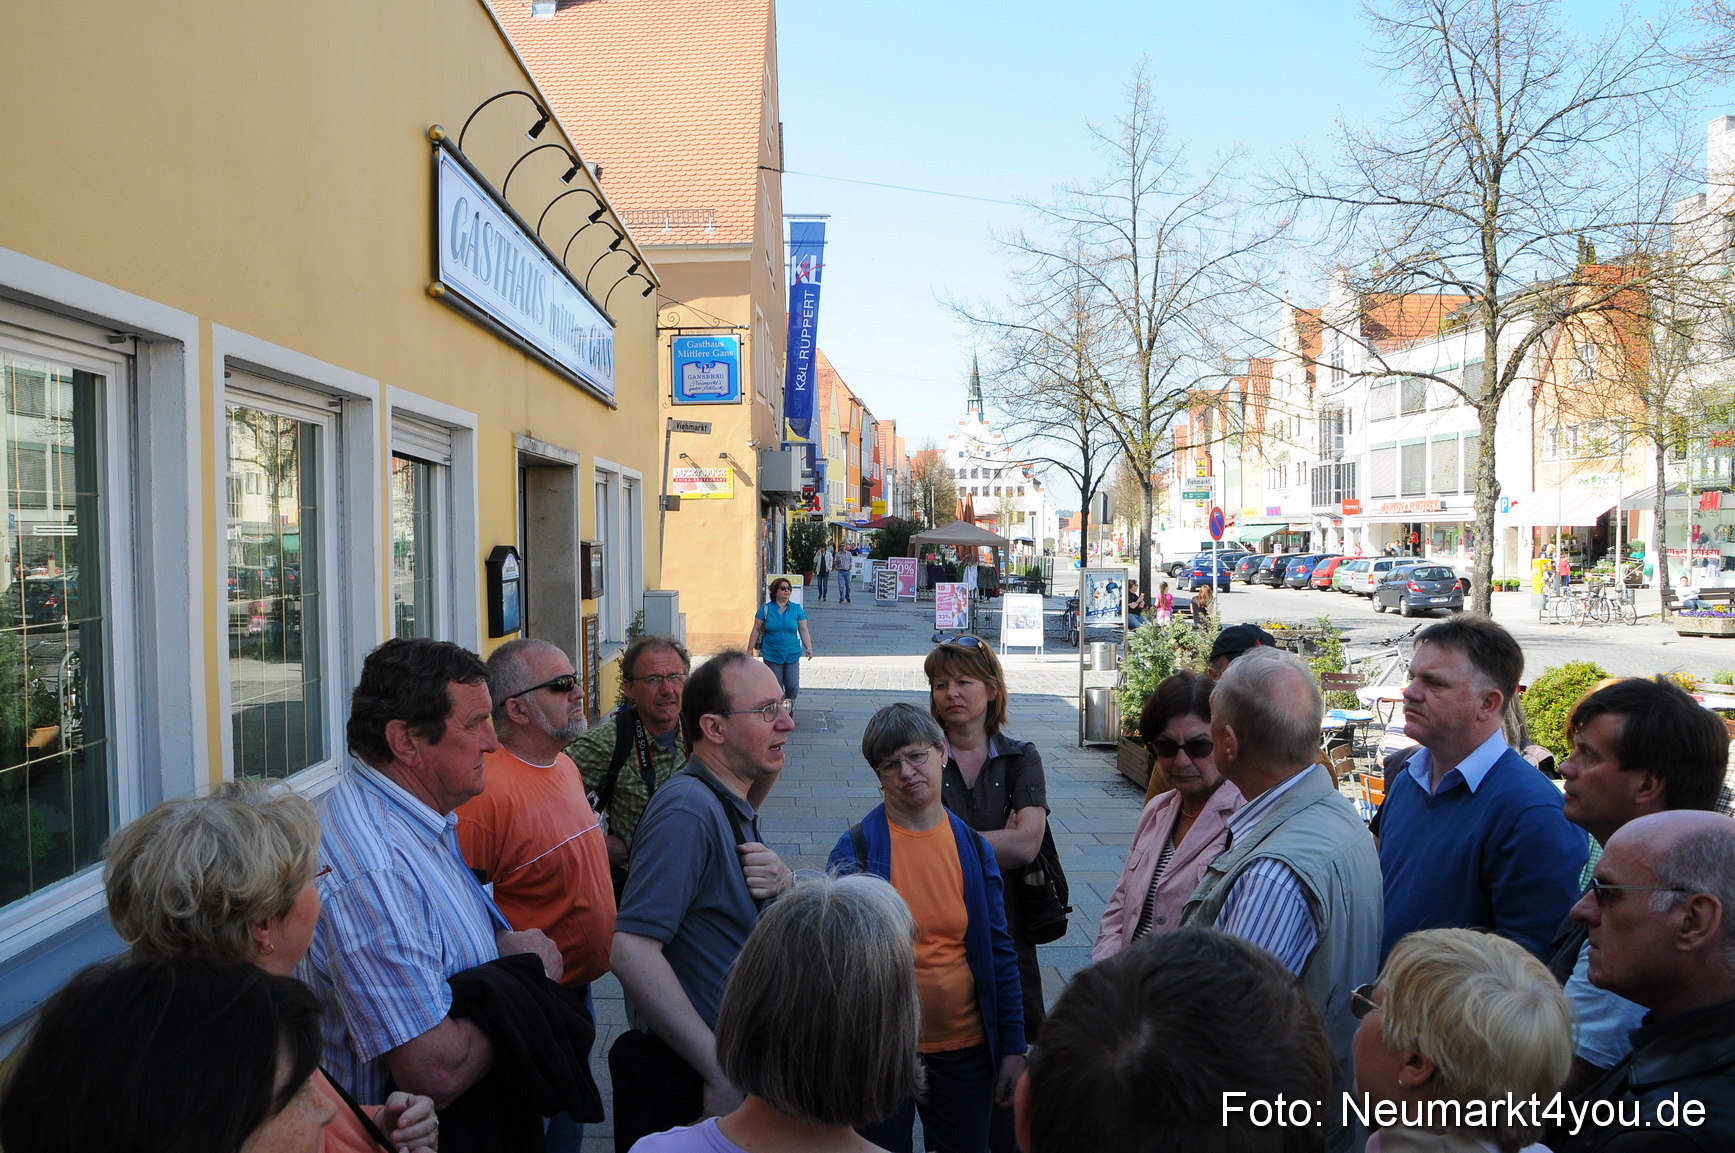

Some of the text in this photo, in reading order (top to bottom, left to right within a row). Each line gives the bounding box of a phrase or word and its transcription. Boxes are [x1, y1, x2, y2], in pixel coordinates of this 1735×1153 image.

[450, 196, 612, 380] GASTHAUS mittlere GANS
[686, 340, 725, 349] Gasthaus
[795, 290, 815, 391] K&L RUPPERT
[678, 349, 734, 358] Mittlere Gans
[676, 422, 707, 432] Viehmarkt
[891, 563, 915, 574] 20%
